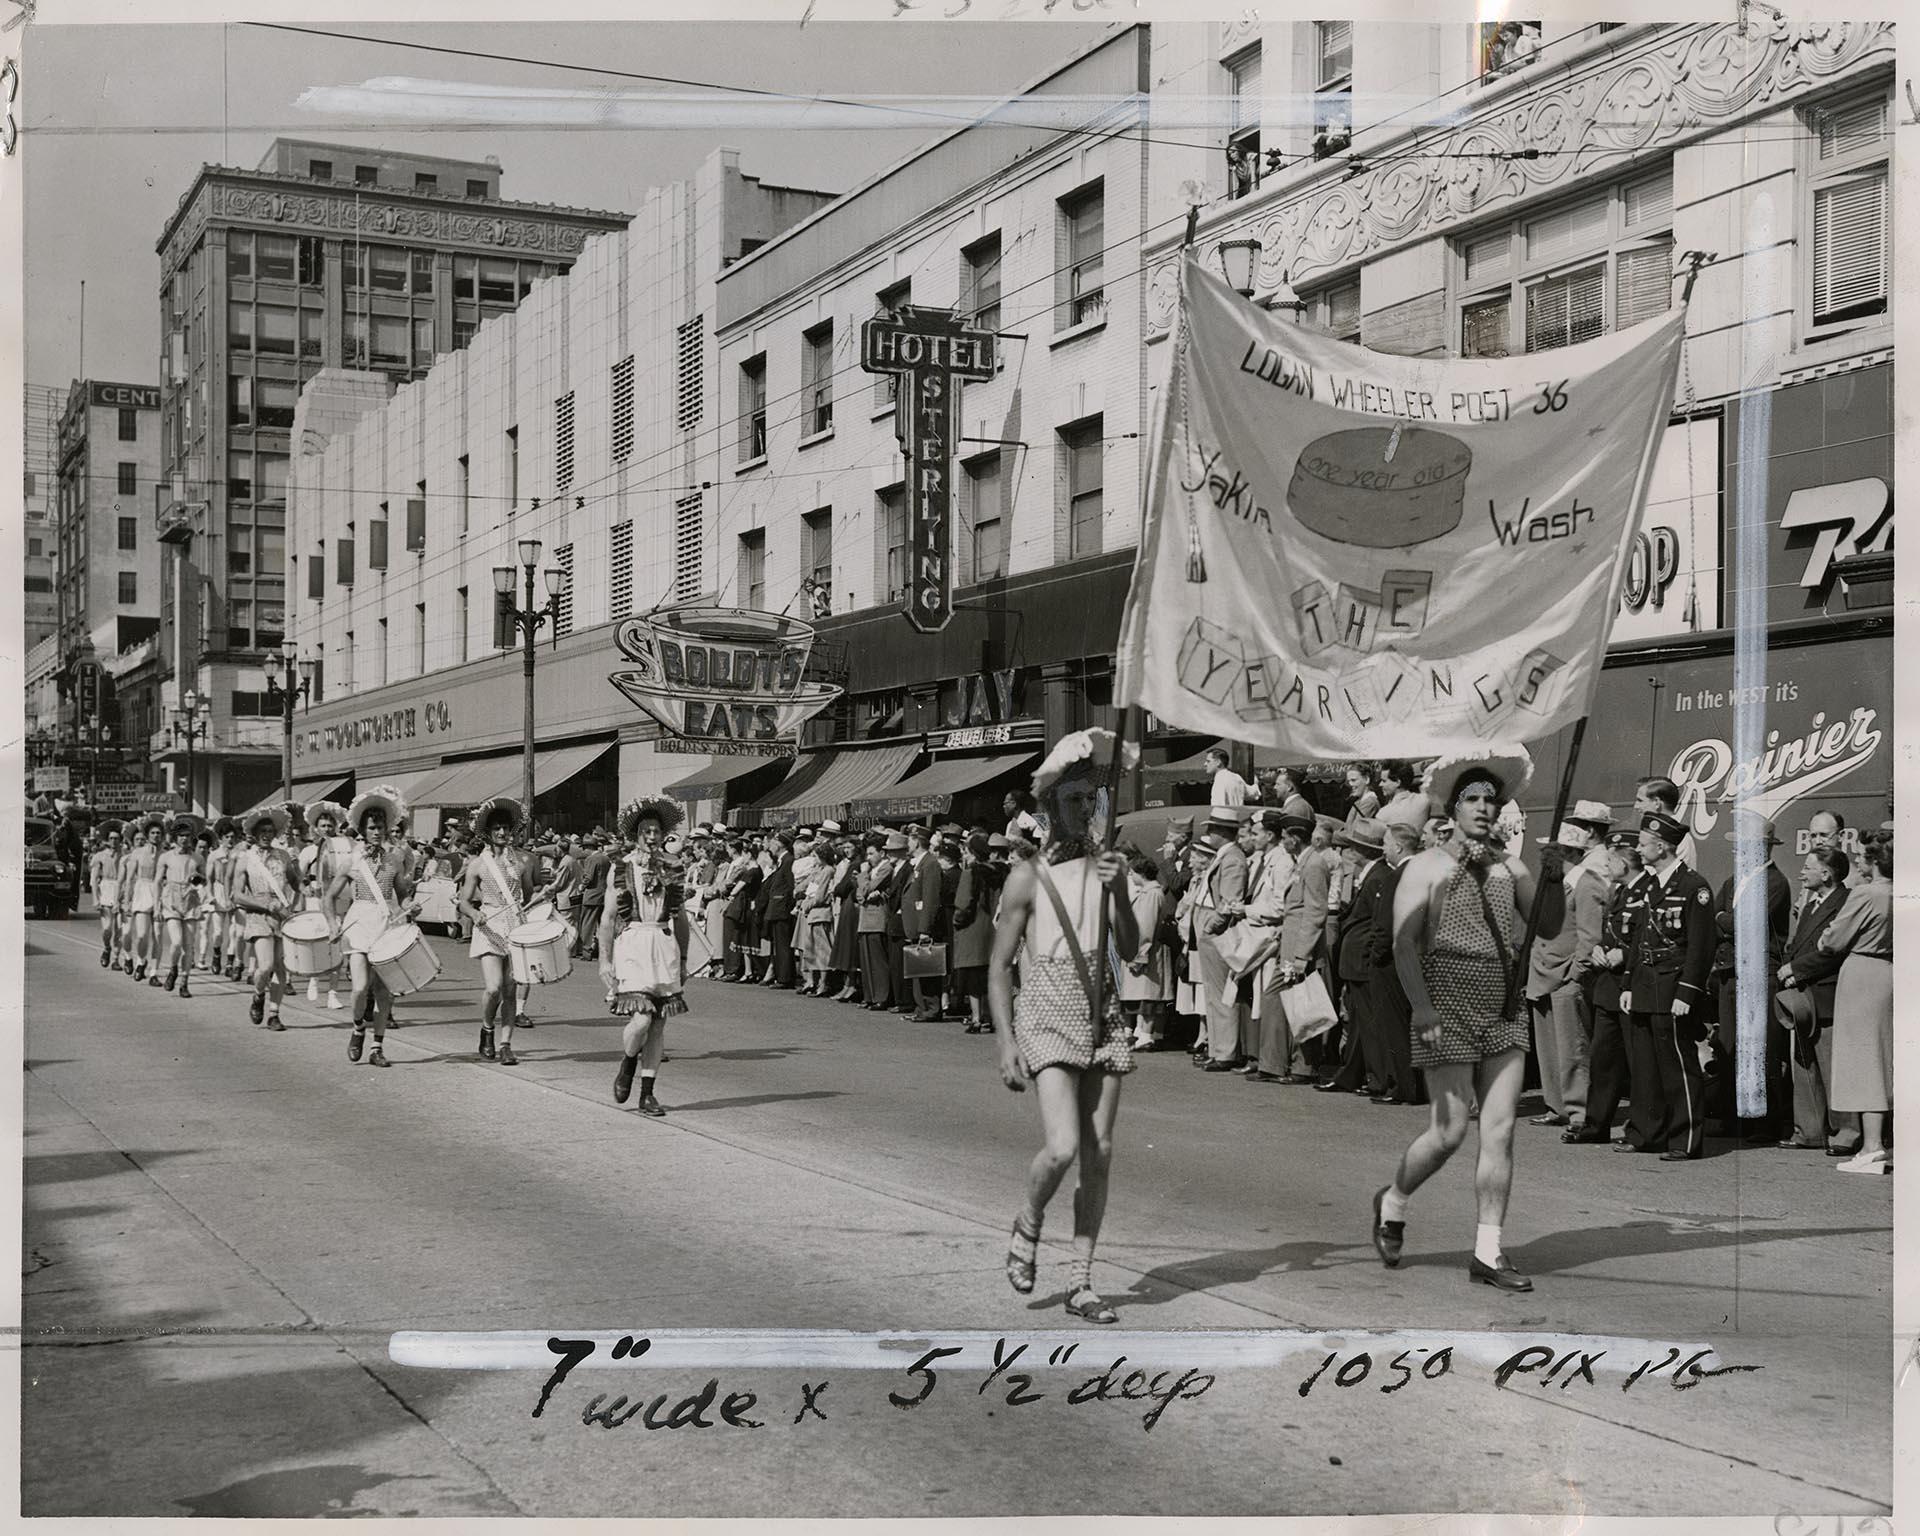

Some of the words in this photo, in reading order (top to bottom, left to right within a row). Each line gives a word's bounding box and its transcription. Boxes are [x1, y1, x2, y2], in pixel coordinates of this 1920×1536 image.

[876, 331, 993, 370] HOTEL
[1239, 340, 1315, 400] LOGAN
[1329, 374, 1437, 420] WHEELER
[1451, 388, 1513, 422] POST
[1533, 379, 1569, 415] 36
[921, 375, 943, 612] STERLING
[1308, 456, 1342, 478] one
[1351, 467, 1401, 490] year
[1413, 463, 1445, 485] old
[1489, 497, 1595, 547] Wash
[1305, 588, 1417, 646] THE
[947, 668, 1016, 726] JAY
[1200, 649, 1546, 728] YEARLINGS
[1675, 691, 1692, 712] In
[1697, 689, 1724, 710] the
[1728, 685, 1770, 706] WEST
[1775, 680, 1799, 702] it's
[324, 707, 416, 750] WOOLWORTH
[685, 700, 778, 738] EATS
[945, 726, 1012, 748] JEWELERS
[1667, 707, 1882, 840] Rainier
[884, 795, 944, 815] JEWELERS
[1795, 828, 1861, 855] BR
